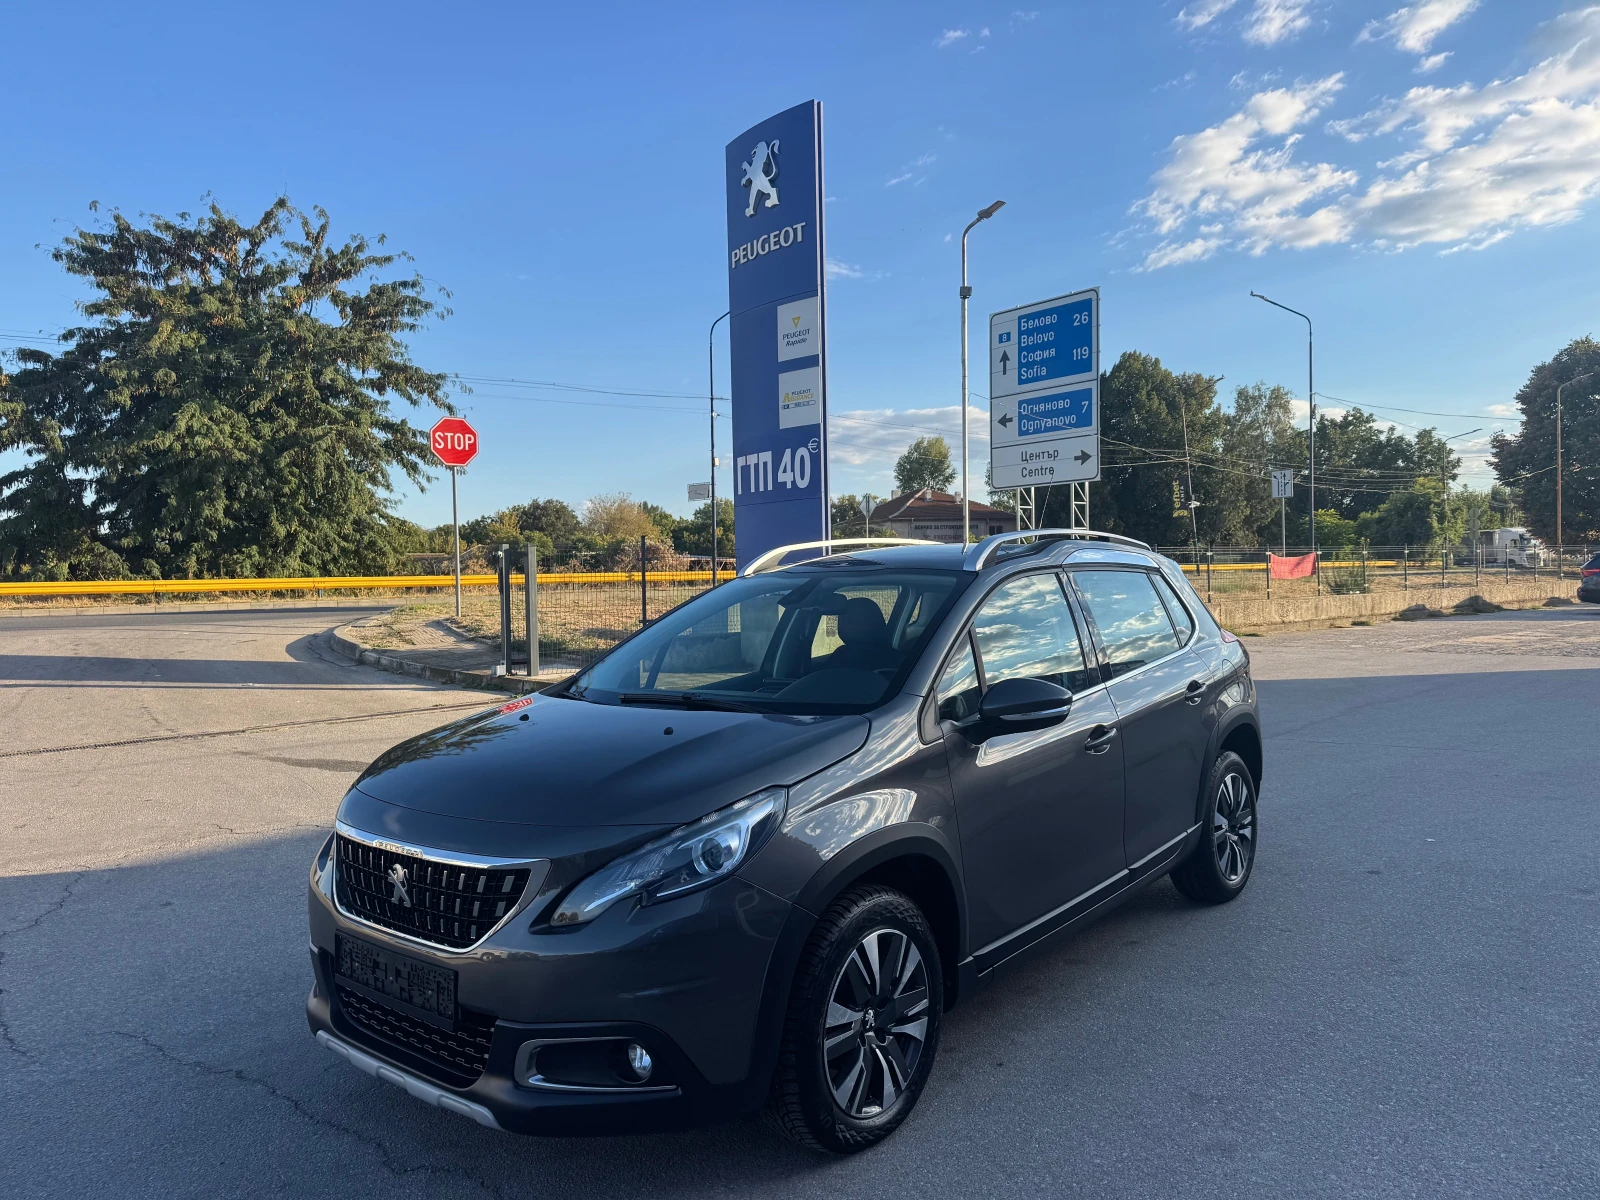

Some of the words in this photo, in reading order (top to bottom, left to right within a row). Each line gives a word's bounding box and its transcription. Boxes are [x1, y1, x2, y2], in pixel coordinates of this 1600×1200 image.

[731, 222, 806, 269] PEUGEOT
[1021, 314, 1058, 331] Белово
[1073, 312, 1089, 326] 26
[782, 328, 811, 340] PEUGEOT
[1002, 333, 1008, 342] 8
[1021, 331, 1054, 347] Belovo
[785, 338, 807, 347] Rapide
[1021, 348, 1056, 363] София
[1073, 346, 1089, 361] 119
[1020, 366, 1047, 379] Sofia
[1021, 399, 1071, 415] Огняново
[1081, 401, 1089, 414] 7
[1021, 414, 1077, 432] Ognyanovo
[435, 431, 475, 450] STOP
[1021, 449, 1059, 464] Център
[737, 451, 773, 495] ГТП
[1021, 466, 1055, 478] Centre
[1172, 480, 1181, 508] efbet
